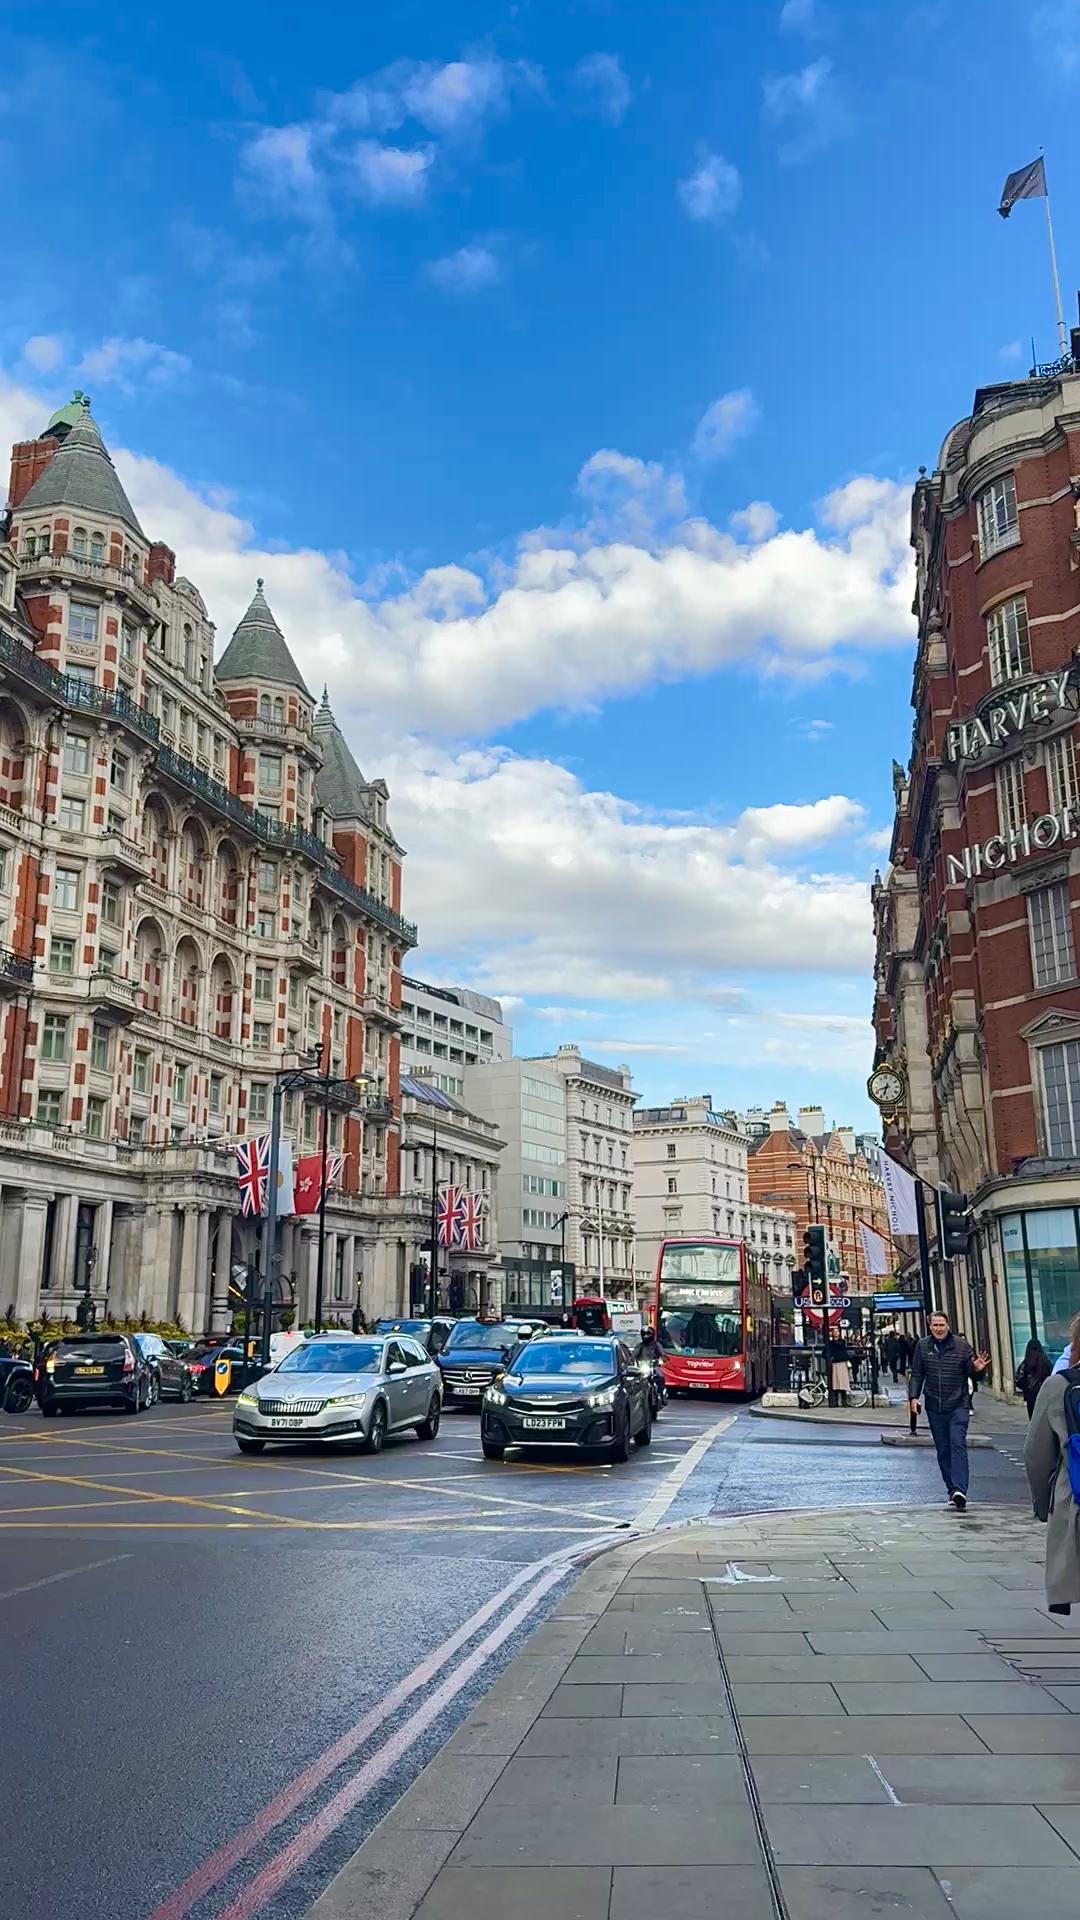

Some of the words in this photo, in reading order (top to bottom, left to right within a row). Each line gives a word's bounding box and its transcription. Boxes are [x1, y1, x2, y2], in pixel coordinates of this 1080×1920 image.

[947, 671, 1070, 762] HARVEY
[883, 1160, 895, 1192] HARVEY
[889, 1195, 901, 1233] NICHOLS
[271, 1418, 287, 1427] BV71
[525, 1418, 546, 1428] LD23
